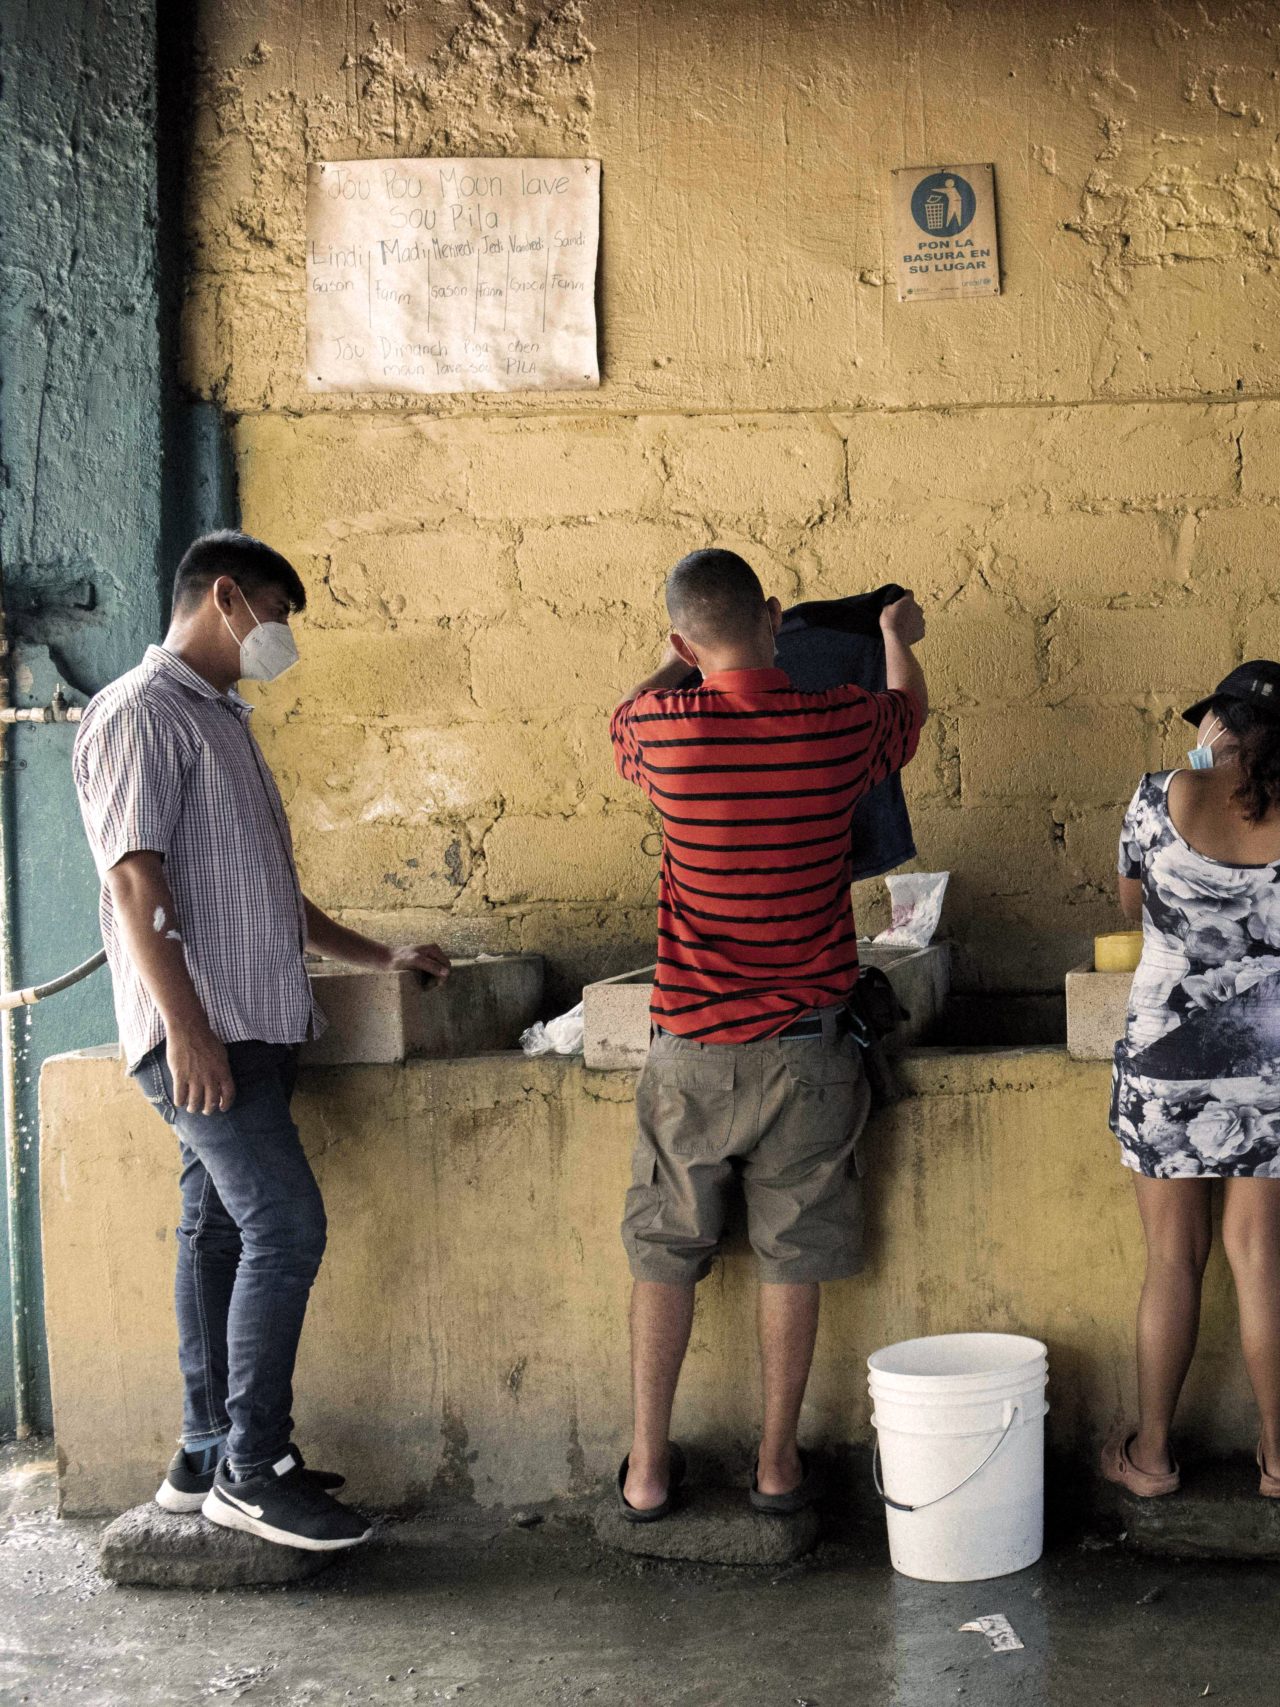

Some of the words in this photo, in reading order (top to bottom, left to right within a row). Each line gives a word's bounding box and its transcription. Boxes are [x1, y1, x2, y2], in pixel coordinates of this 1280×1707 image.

[327, 168, 370, 200] Jou
[384, 167, 422, 199] Pou
[439, 168, 502, 199] Moun
[521, 168, 570, 196] lave
[450, 203, 498, 231] Pila
[918, 240, 949, 250] PON
[955, 239, 974, 248] LA
[312, 240, 362, 268] Lindi
[903, 251, 965, 262] BASURA
[970, 249, 990, 257] EN
[909, 265, 929, 274] SU
[935, 261, 986, 272] LUGAR
[313, 277, 355, 293] Gason
[504, 357, 536, 375] PILA
